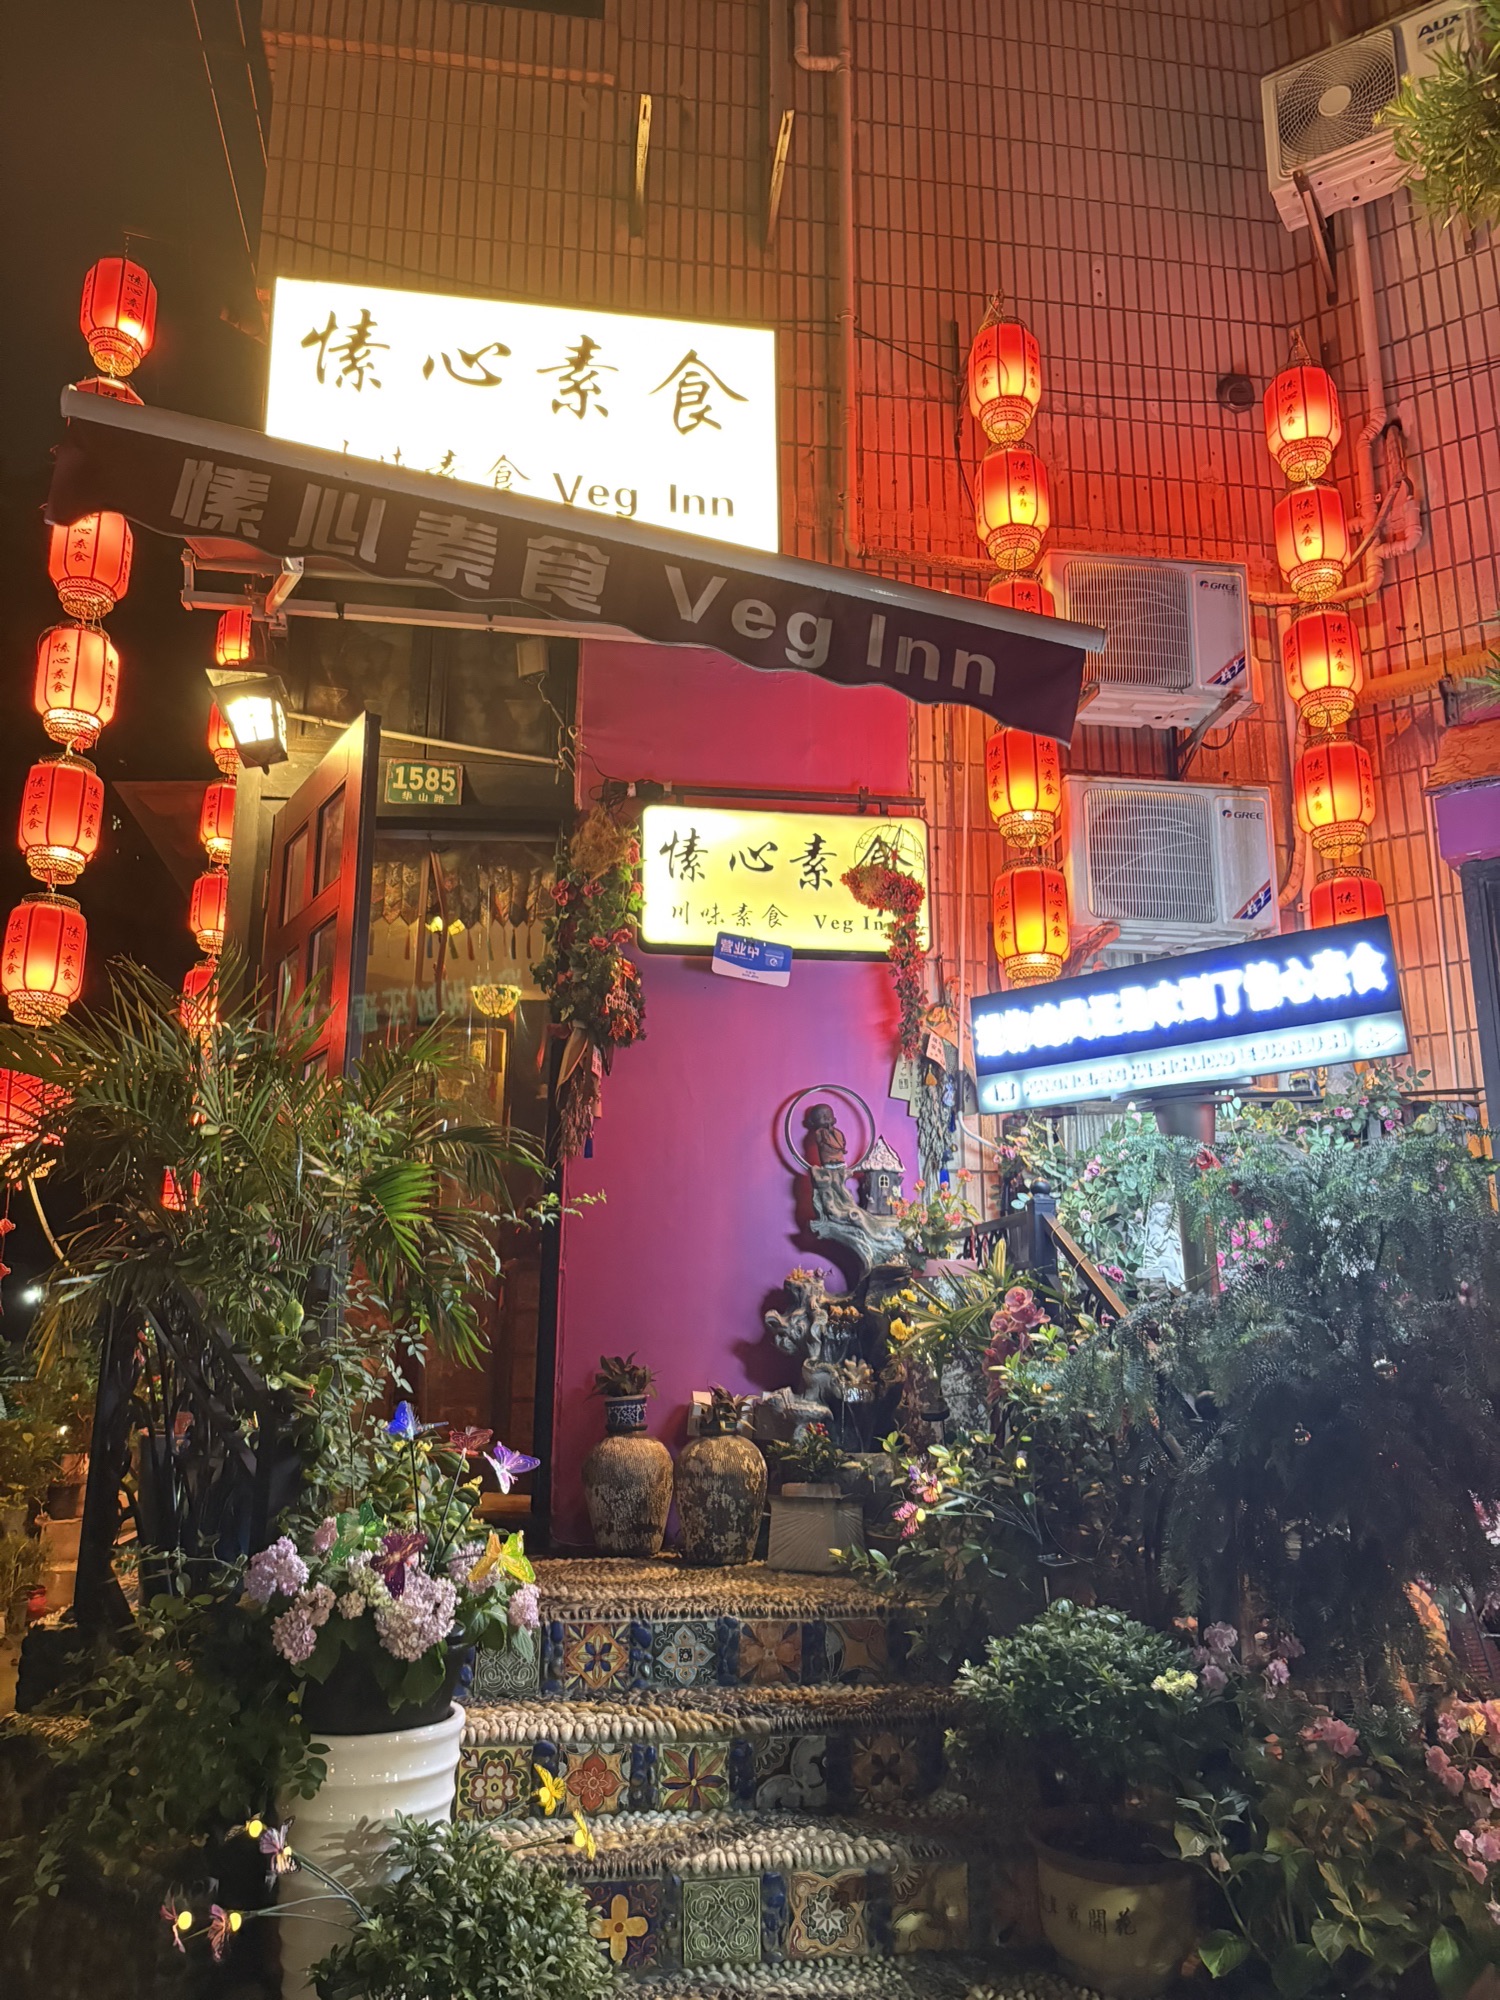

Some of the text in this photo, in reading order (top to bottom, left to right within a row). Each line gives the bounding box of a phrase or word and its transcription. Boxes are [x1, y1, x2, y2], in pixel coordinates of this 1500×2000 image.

[1418, 13, 1461, 38] AUX
[301, 308, 749, 434] 愫心素食
[553, 473, 638, 517] Veg
[669, 484, 734, 517] Inn
[170, 457, 611, 614] 愫心素食
[664, 564, 833, 669] Veg
[866, 614, 996, 697] Inn
[51, 642, 71, 693] 愫心素食
[393, 766, 456, 793] 1585
[26, 777, 46, 830] 愫心素食
[1234, 811, 1263, 820] GREE
[672, 901, 897, 933] 川味素食 Veg In
[60, 925, 81, 982] 愫心素食
